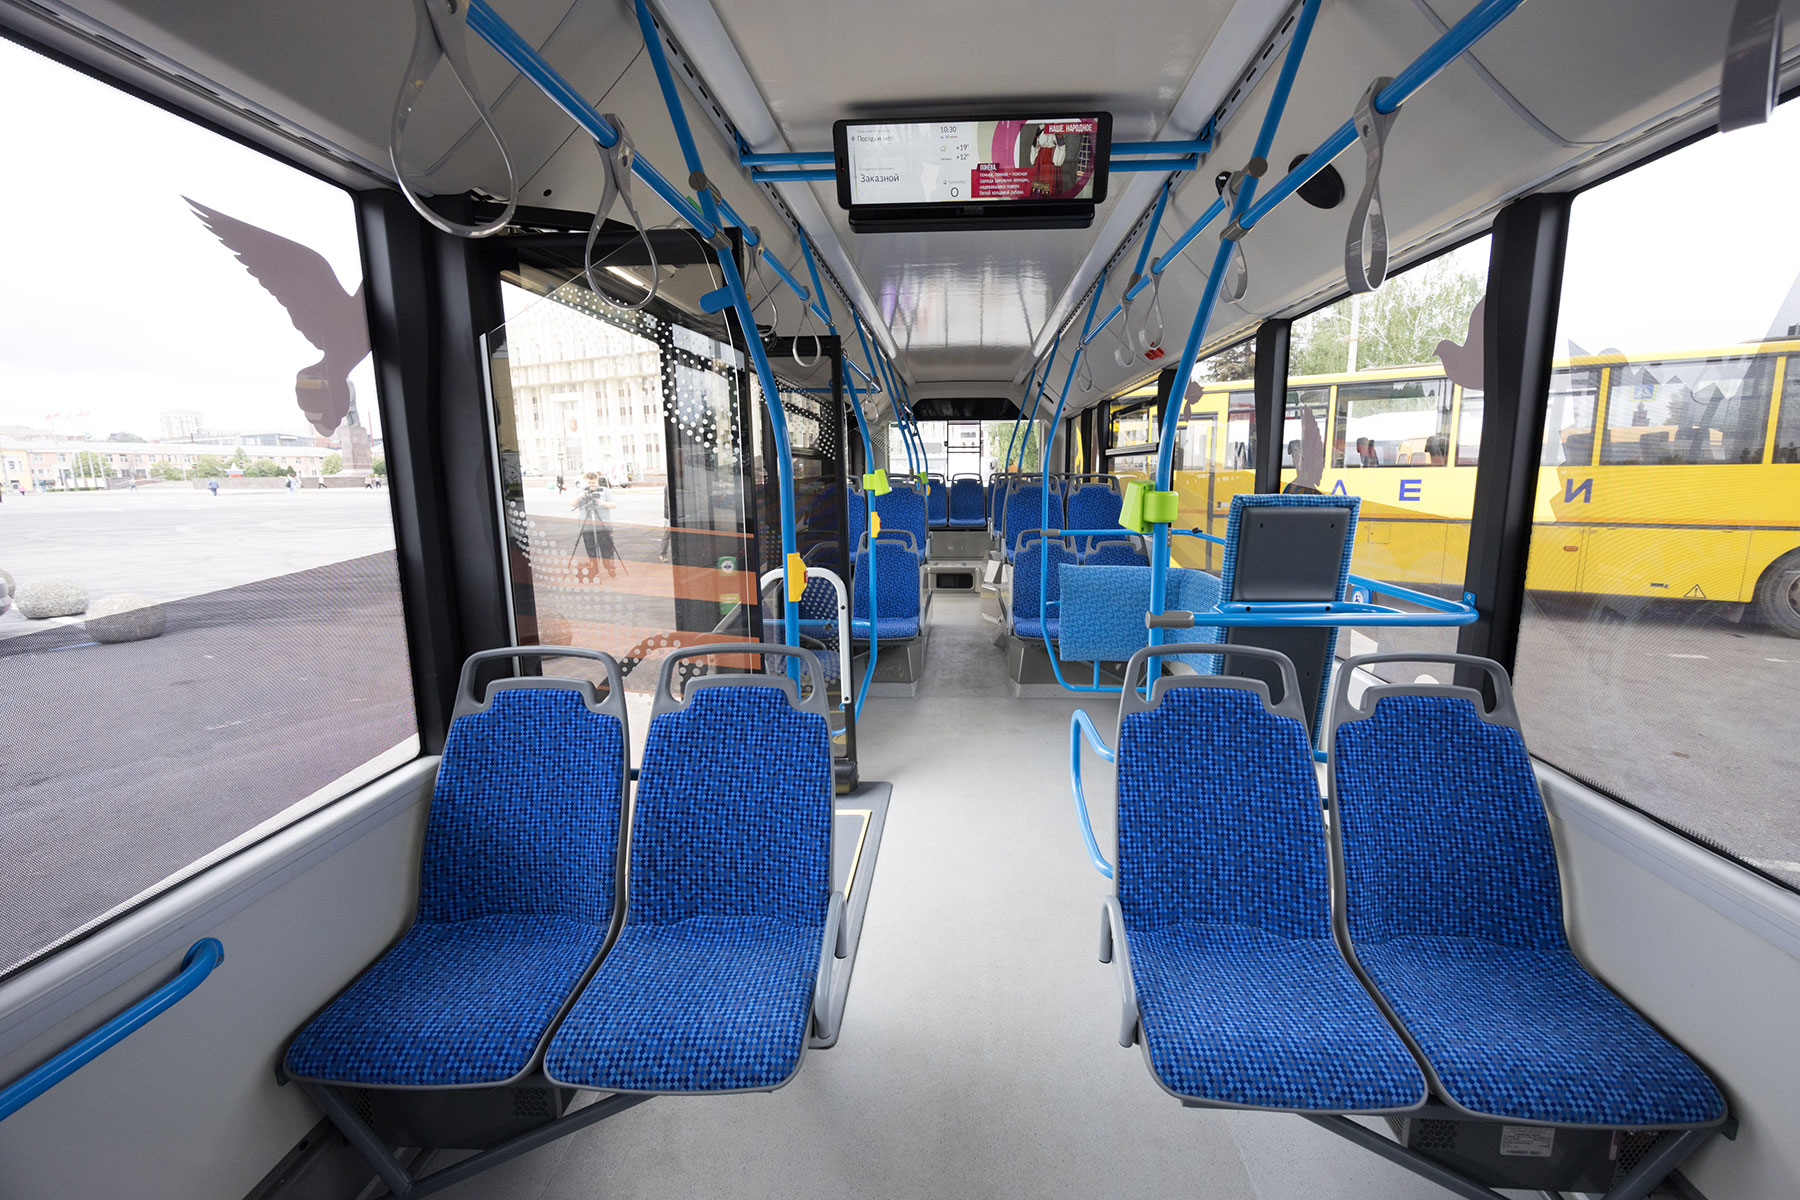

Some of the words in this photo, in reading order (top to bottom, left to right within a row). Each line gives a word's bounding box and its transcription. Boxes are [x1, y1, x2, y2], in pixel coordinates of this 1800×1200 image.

[940, 125, 957, 133] 10:30
[1066, 124, 1092, 132] НАРОДНОЕ
[860, 173, 900, 183] Заказной
